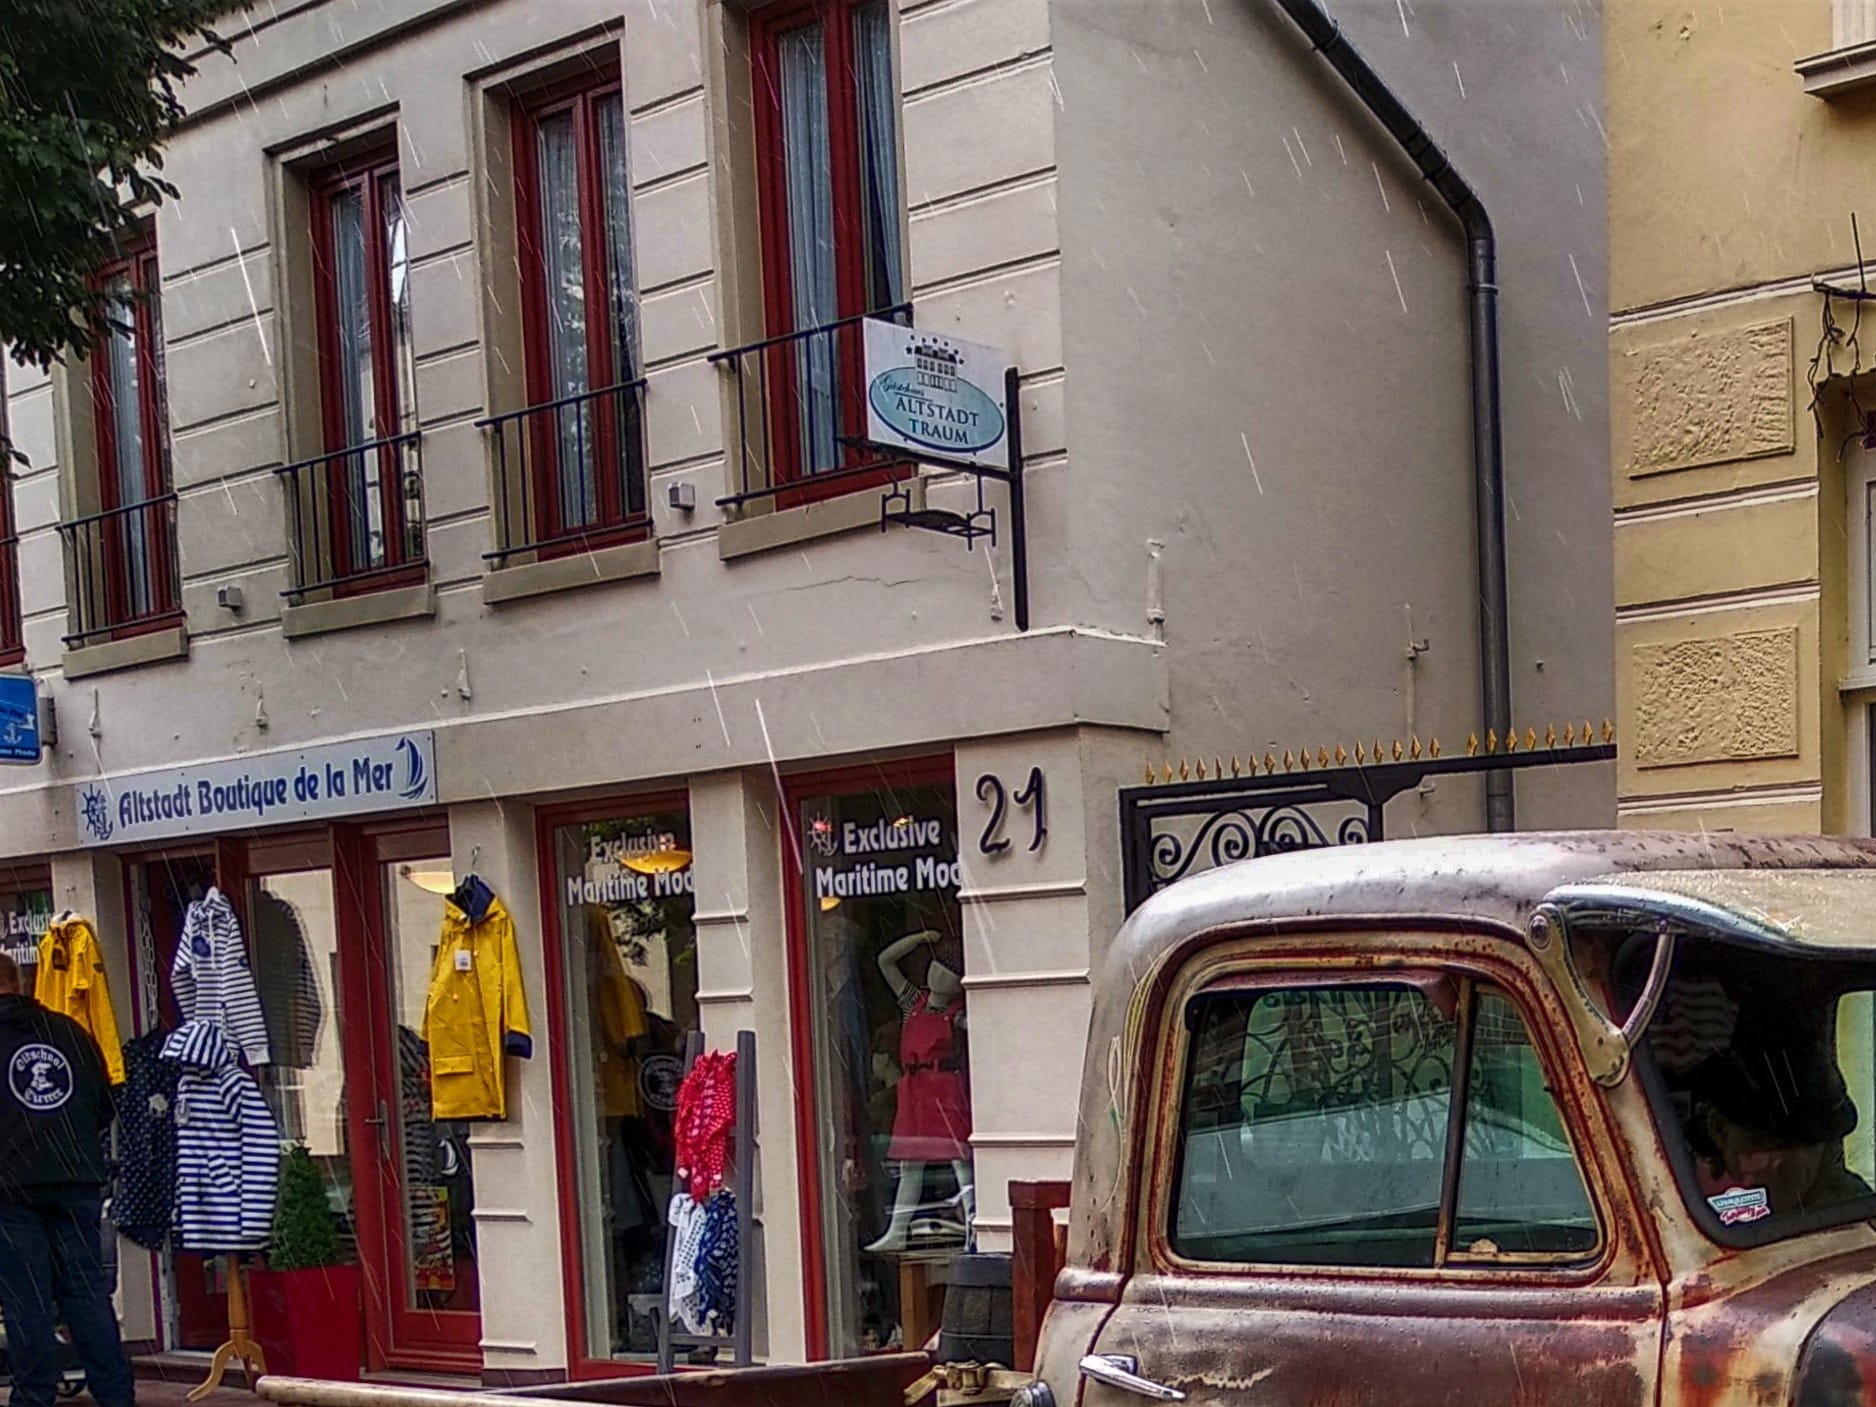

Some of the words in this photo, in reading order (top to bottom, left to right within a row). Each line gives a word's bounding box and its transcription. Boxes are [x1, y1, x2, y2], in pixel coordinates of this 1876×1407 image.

[896, 397, 979, 427] ALTSTADT
[909, 418, 968, 444] TRAUM
[119, 783, 192, 829] Altstadt
[198, 774, 287, 816] Boutique
[294, 766, 318, 802] de
[326, 762, 345, 798] la
[352, 756, 394, 795] Mer
[975, 766, 1049, 855] 21
[843, 815, 941, 854] Exclusive
[567, 870, 648, 905] Maritime
[654, 864, 695, 897] Mod
[816, 862, 909, 898] Maritime
[916, 856, 962, 890] Mod
